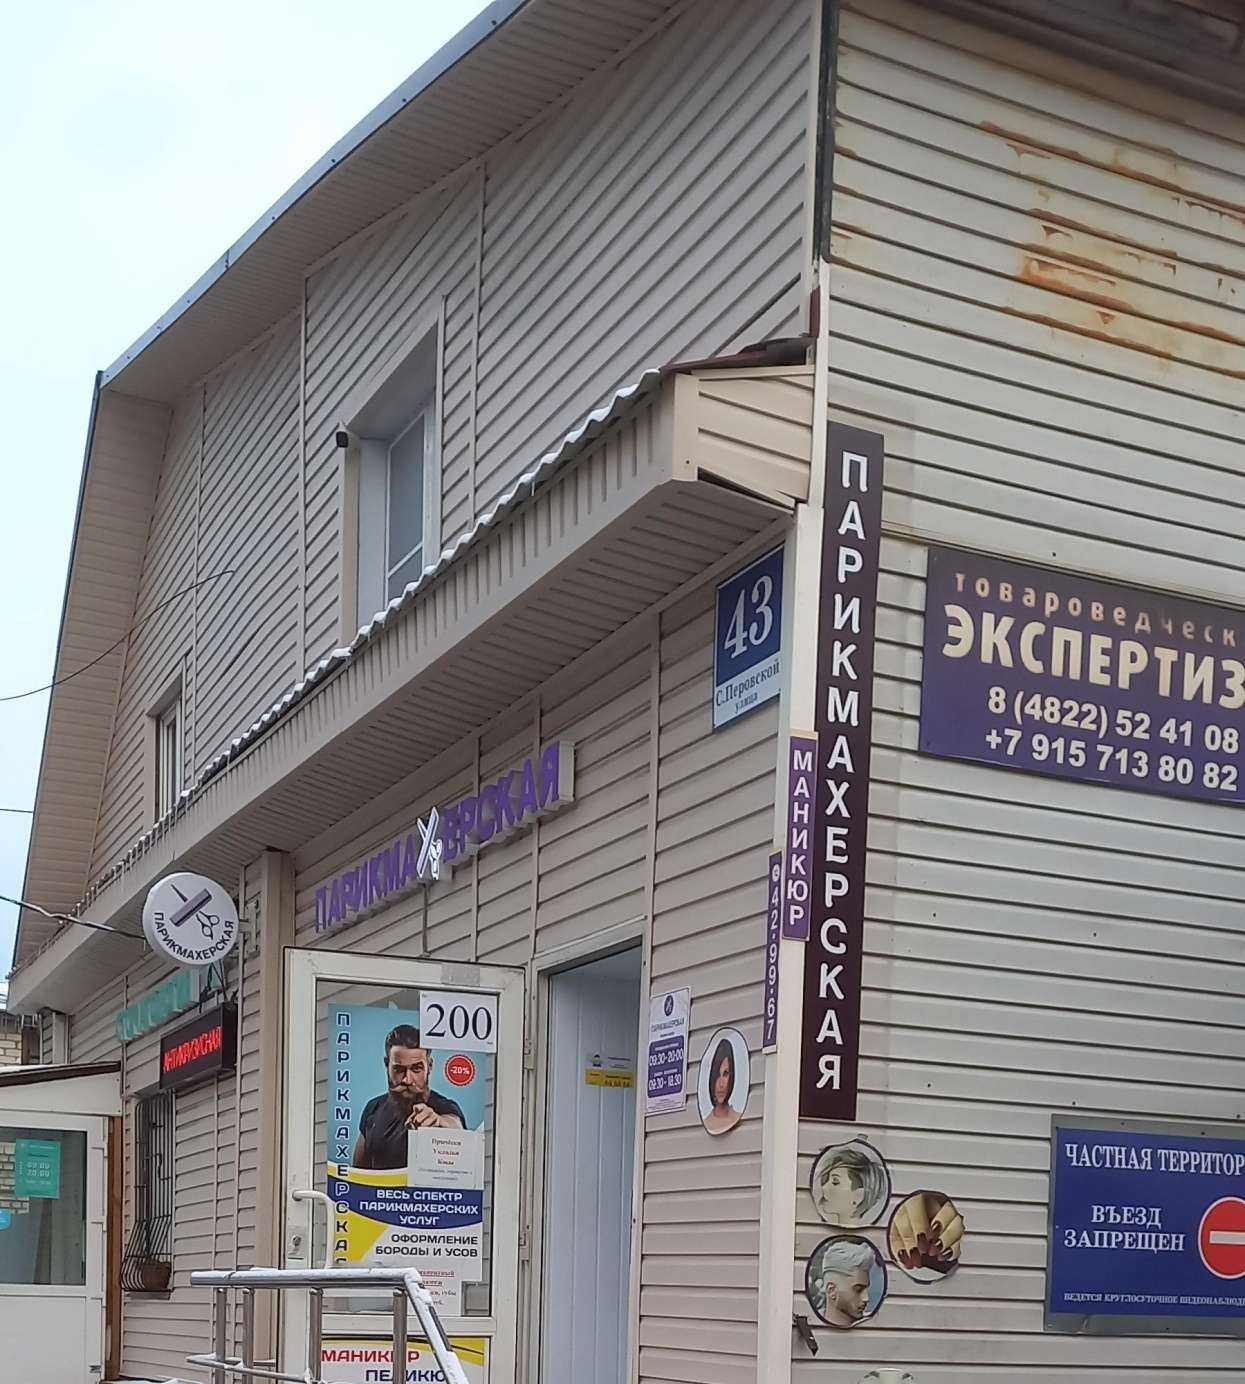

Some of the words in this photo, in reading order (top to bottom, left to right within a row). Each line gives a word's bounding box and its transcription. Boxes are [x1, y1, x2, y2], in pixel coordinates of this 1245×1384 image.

[724, 575, 773, 659] 43
[942, 604, 1245, 710] ЭКСПЕРТИЗ
[716, 657, 780, 707] С.Перовской
[735, 692, 758, 715] улица
[988, 686, 1006, 714] 8
[1014, 690, 1108, 739] (4822)
[1115, 709, 1151, 739] 52
[1159, 718, 1192, 746] 41
[1204, 724, 1239, 754] 08
[815, 451, 868, 1091] ПАРИКМАХЕРСКАЯ
[985, 728, 1022, 756] +7
[1032, 733, 1086, 767] 915
[1096, 744, 1149, 778] 713
[1158, 755, 1193, 785] 80
[1202, 762, 1239, 792] 82
[787, 749, 812, 926] МАНИКЮР
[154, 911, 234, 960] ПАРИКМАХЕРСКАЯ
[425, 1003, 493, 1041] 200
[1065, 1144, 1153, 1171] ЧАСТНАЯ
[1157, 1149, 1245, 1176] ТЕРРИТОР
[359, 1201, 479, 1215] ПАРИКМАХЕРСКИХ
[376, 1189, 411, 1200] ВЕСЬ
[413, 1190, 463, 1202] СПЕКТР
[399, 1215, 440, 1226] УСЛУГ
[1091, 1205, 1161, 1229] ВЪЕЗД
[375, 1245, 429, 1257] БОРОДЫ
[432, 1247, 442, 1257] И
[445, 1247, 478, 1258] УСОВ
[391, 1233, 479, 1246] ОФОРМЛЕНИЕ
[1064, 1230, 1185, 1254] ЗАПРЕЩЕН
[321, 1350, 420, 1363] МАНИКР
